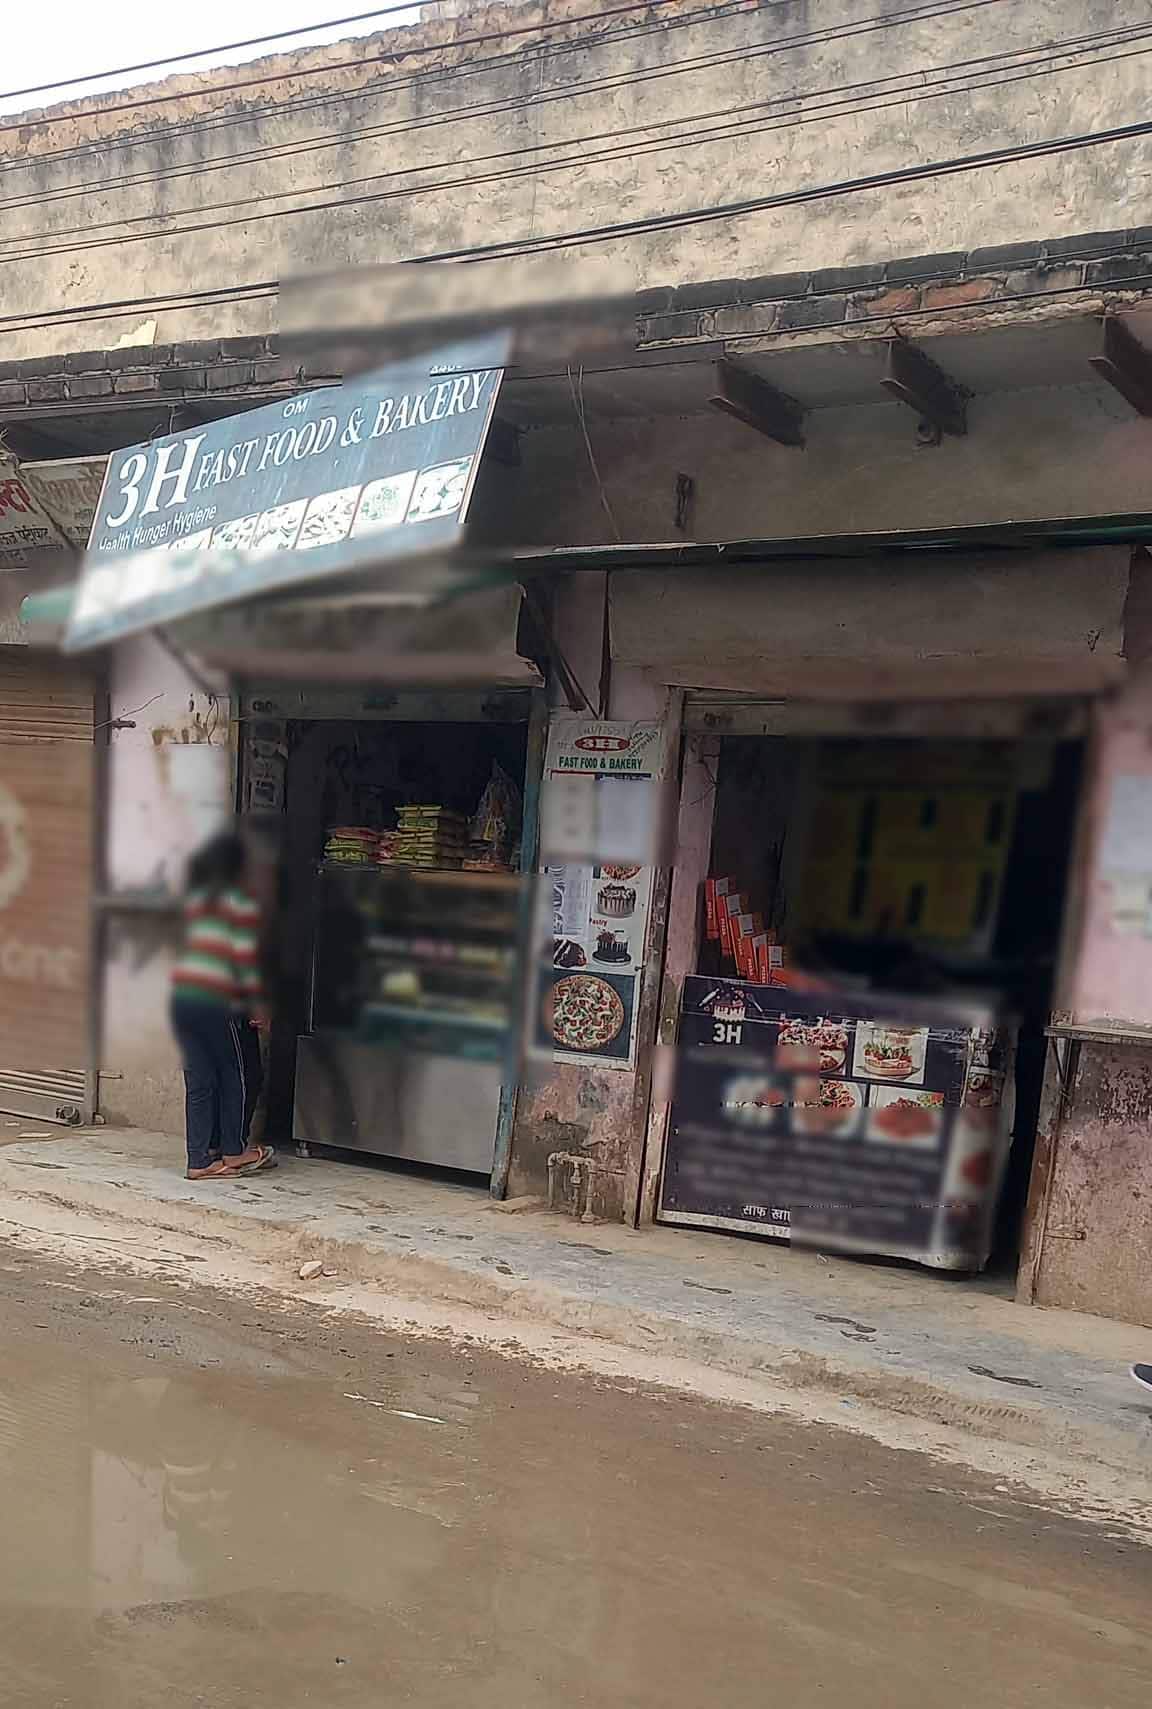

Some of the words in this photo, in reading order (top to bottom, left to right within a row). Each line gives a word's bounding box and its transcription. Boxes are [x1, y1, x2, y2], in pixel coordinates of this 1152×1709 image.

[282, 397, 310, 418] OM
[105, 432, 207, 529] 3H
[191, 438, 260, 493] FAST
[256, 416, 338, 472] FOOD
[339, 407, 365, 446] &
[371, 370, 491, 437] BAKERY
[132, 518, 172, 546] Hunger
[172, 505, 218, 535] Hygiene
[559, 756, 579, 768] FAST
[580, 757, 598, 768] FOOD
[599, 757, 606, 769] &
[609, 758, 643, 769] BAKERY
[712, 1022, 742, 1044] 3H
[743, 1205, 767, 1216] साफ
